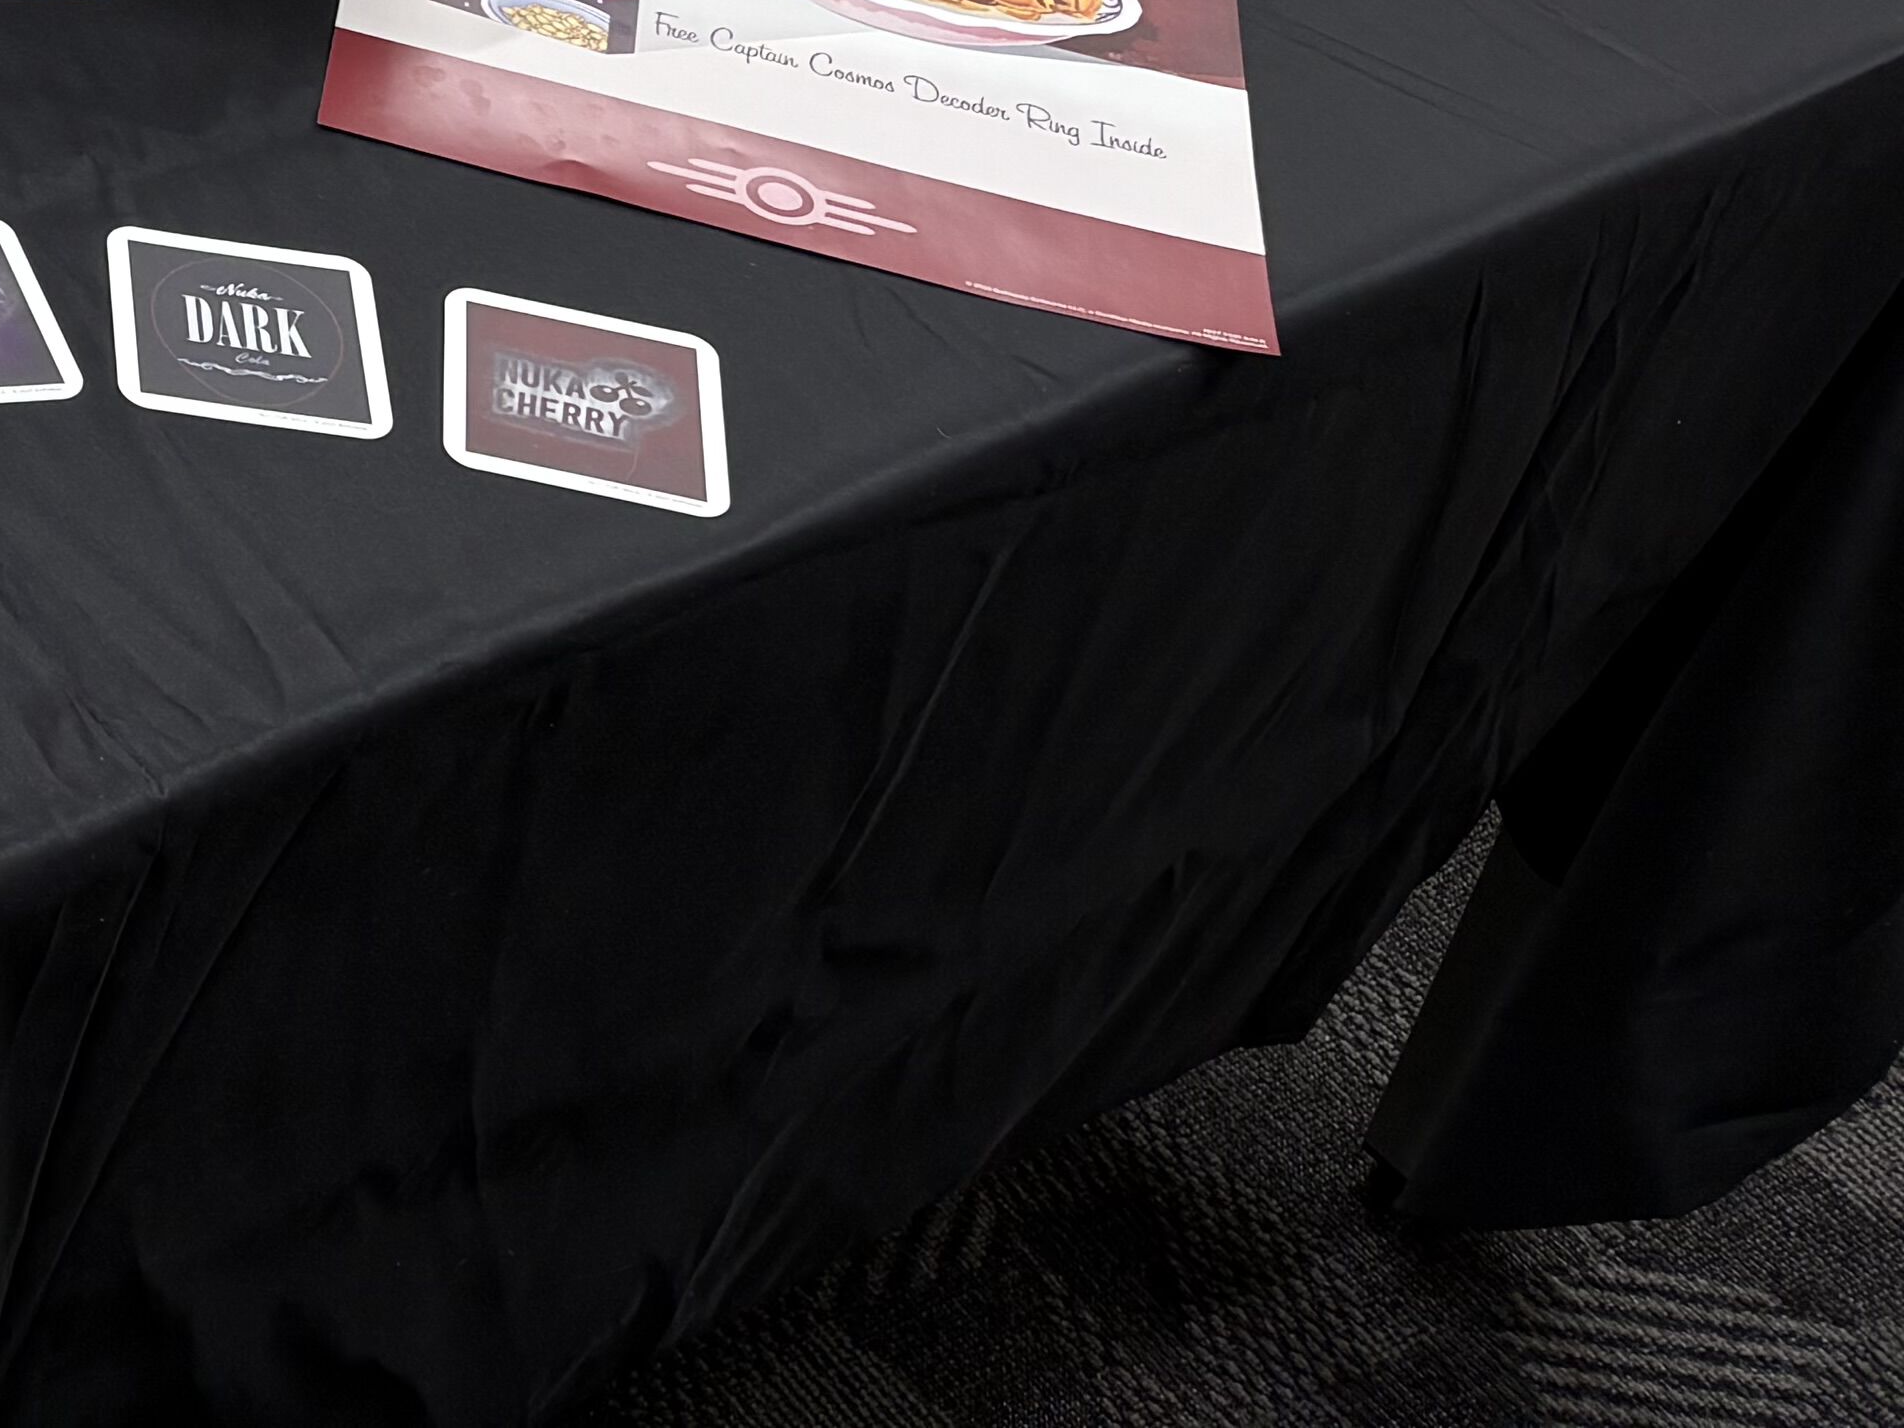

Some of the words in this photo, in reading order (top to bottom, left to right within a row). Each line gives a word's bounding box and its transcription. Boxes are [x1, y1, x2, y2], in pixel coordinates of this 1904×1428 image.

[653, 9, 701, 46] Free
[709, 25, 800, 72] Captain
[809, 51, 896, 95] Cosmos
[903, 73, 1011, 124] Decoder
[1016, 102, 1083, 149] Ring
[1088, 116, 1170, 162] Inside
[215, 283, 274, 300] Nuka
[180, 294, 313, 360] DARK
[235, 351, 272, 366] Cola
[500, 358, 588, 401] NUKA
[494, 386, 629, 441] CHERRY
